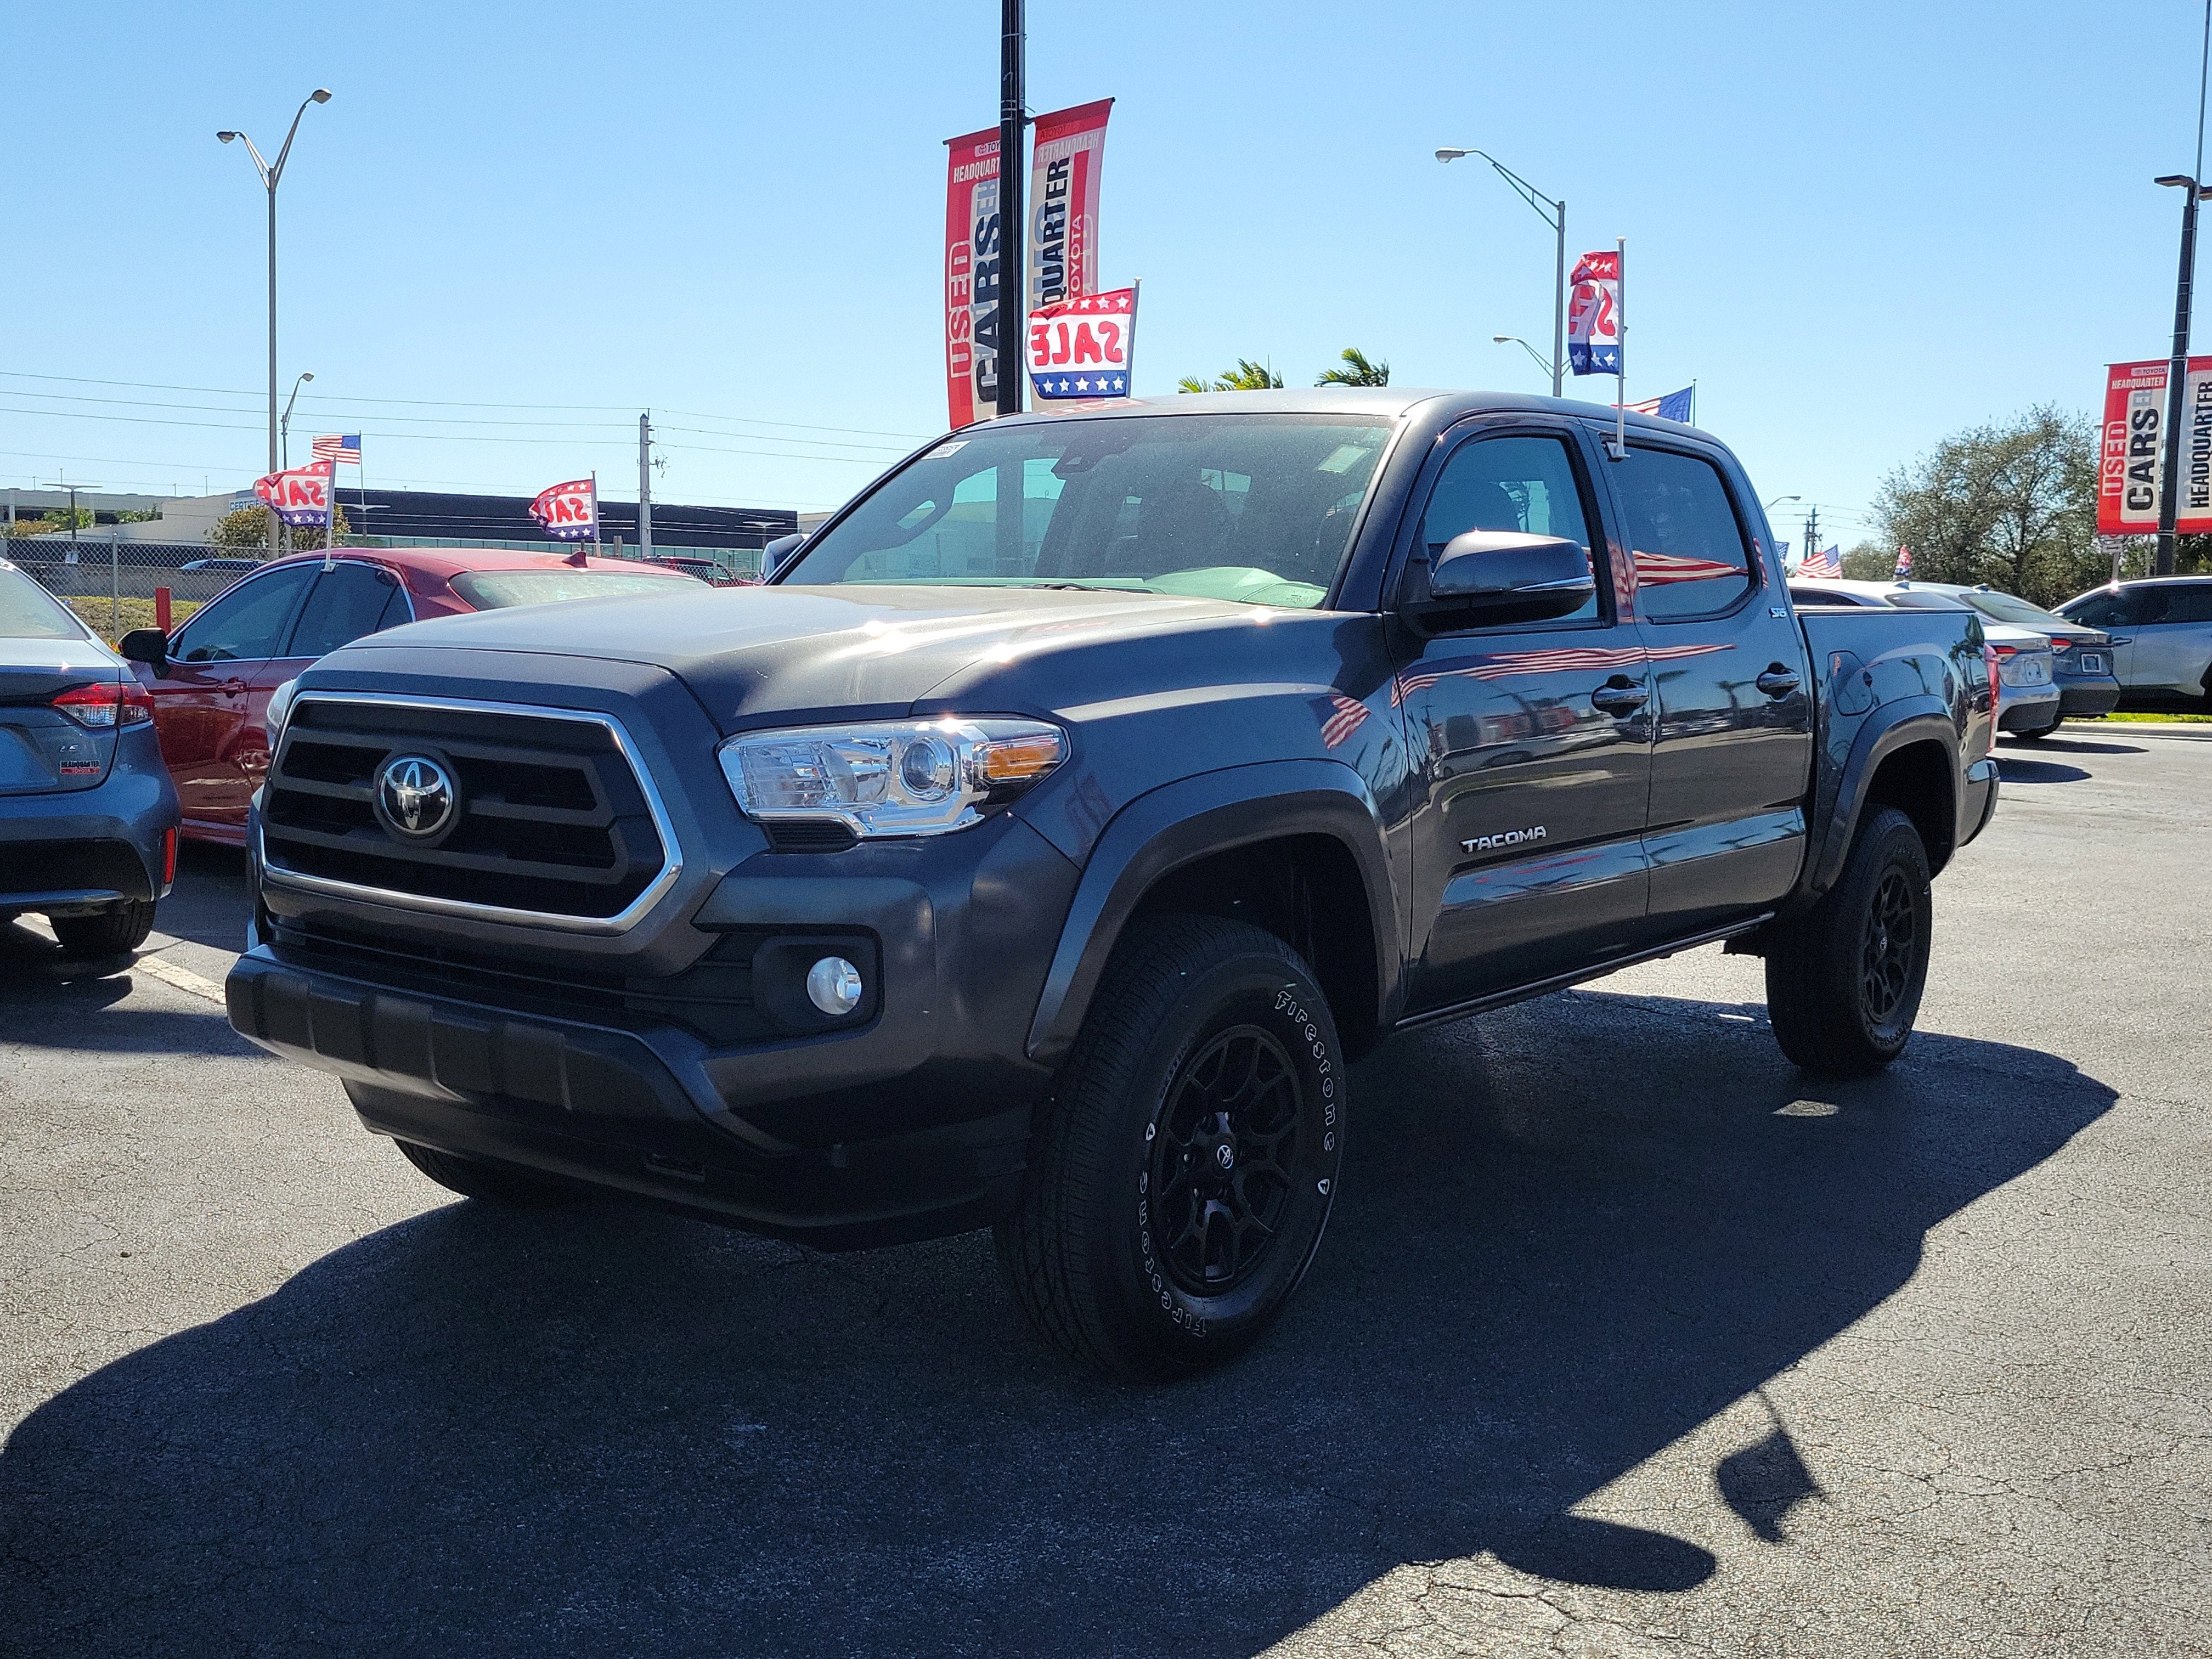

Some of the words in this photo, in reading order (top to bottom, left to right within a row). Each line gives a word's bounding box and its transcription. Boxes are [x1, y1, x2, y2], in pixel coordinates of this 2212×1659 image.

[953, 157, 1000, 184] HEADQUART
[988, 142, 1000, 152] TOY
[1042, 157, 1070, 309] QUARTER
[1071, 215, 1082, 299] OYOTA
[950, 241, 972, 378] USED
[974, 213, 1000, 403] CARS
[2112, 376, 2164, 390] HEADQUARTER
[2103, 422, 2126, 495] USED
[2127, 408, 2159, 511] CARS
[2190, 381, 2212, 508] HEADQUARTER
[1460, 826, 1547, 853] TACOMA
[1274, 990, 1335, 1153] Firestone
[1139, 1171, 1207, 1338] Firestone
